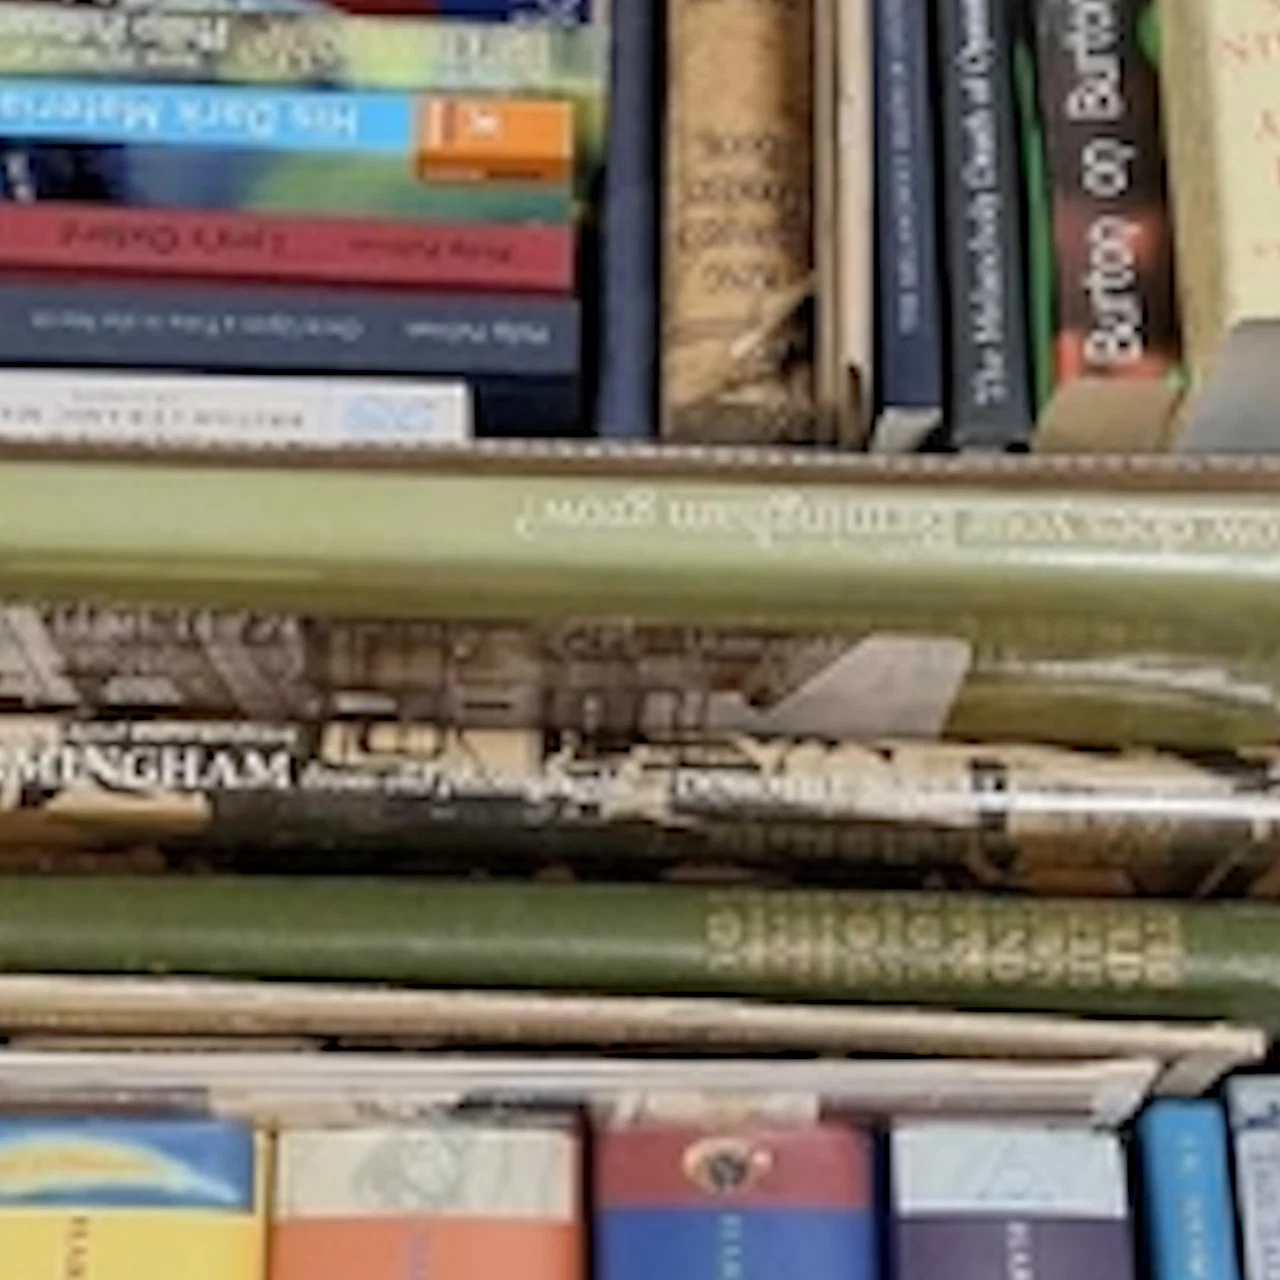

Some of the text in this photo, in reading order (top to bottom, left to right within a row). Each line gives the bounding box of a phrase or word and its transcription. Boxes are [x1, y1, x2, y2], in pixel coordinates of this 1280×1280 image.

[958, 75, 990, 104] of
[177, 95, 273, 136] Dark
[284, 100, 358, 140] His
[959, 110, 996, 188] Death
[1079, 136, 1137, 198] on
[60, 217, 287, 258] Lyra's Oxford
[444, 237, 512, 262] Philip
[964, 192, 1010, 345] Melancholy
[1072, 213, 1151, 363] Burton
[310, 316, 363, 338] Once
[404, 319, 548, 343] Philip Pullman
[972, 348, 1005, 403] The
[513, 485, 656, 536] grow?
[669, 490, 948, 546] Birmingham
[1087, 513, 1197, 555] does
